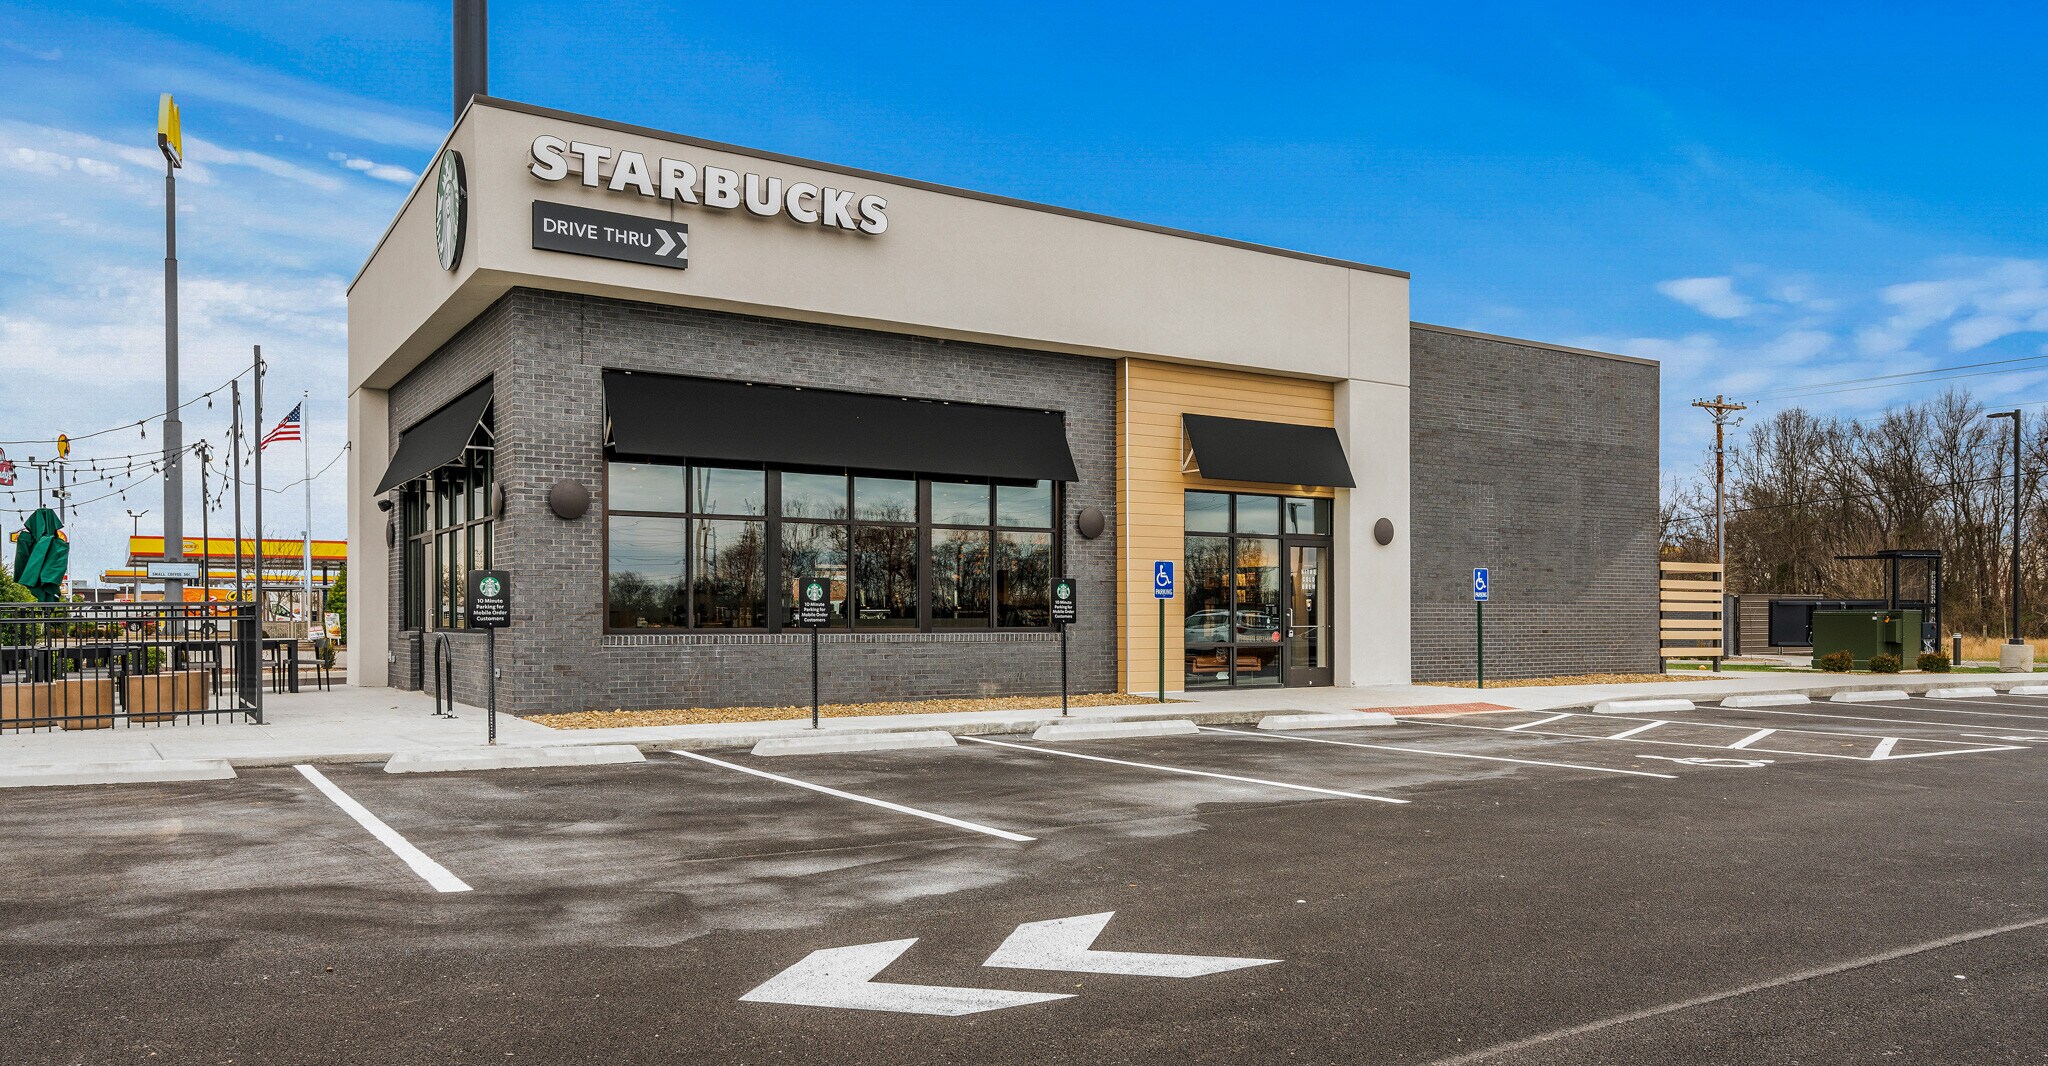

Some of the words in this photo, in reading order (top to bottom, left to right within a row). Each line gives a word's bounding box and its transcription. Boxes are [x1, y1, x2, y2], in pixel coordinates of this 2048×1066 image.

[529, 134, 889, 236] STARBUCKS
[543, 217, 598, 240] DRIVE
[603, 227, 652, 248] THRU
